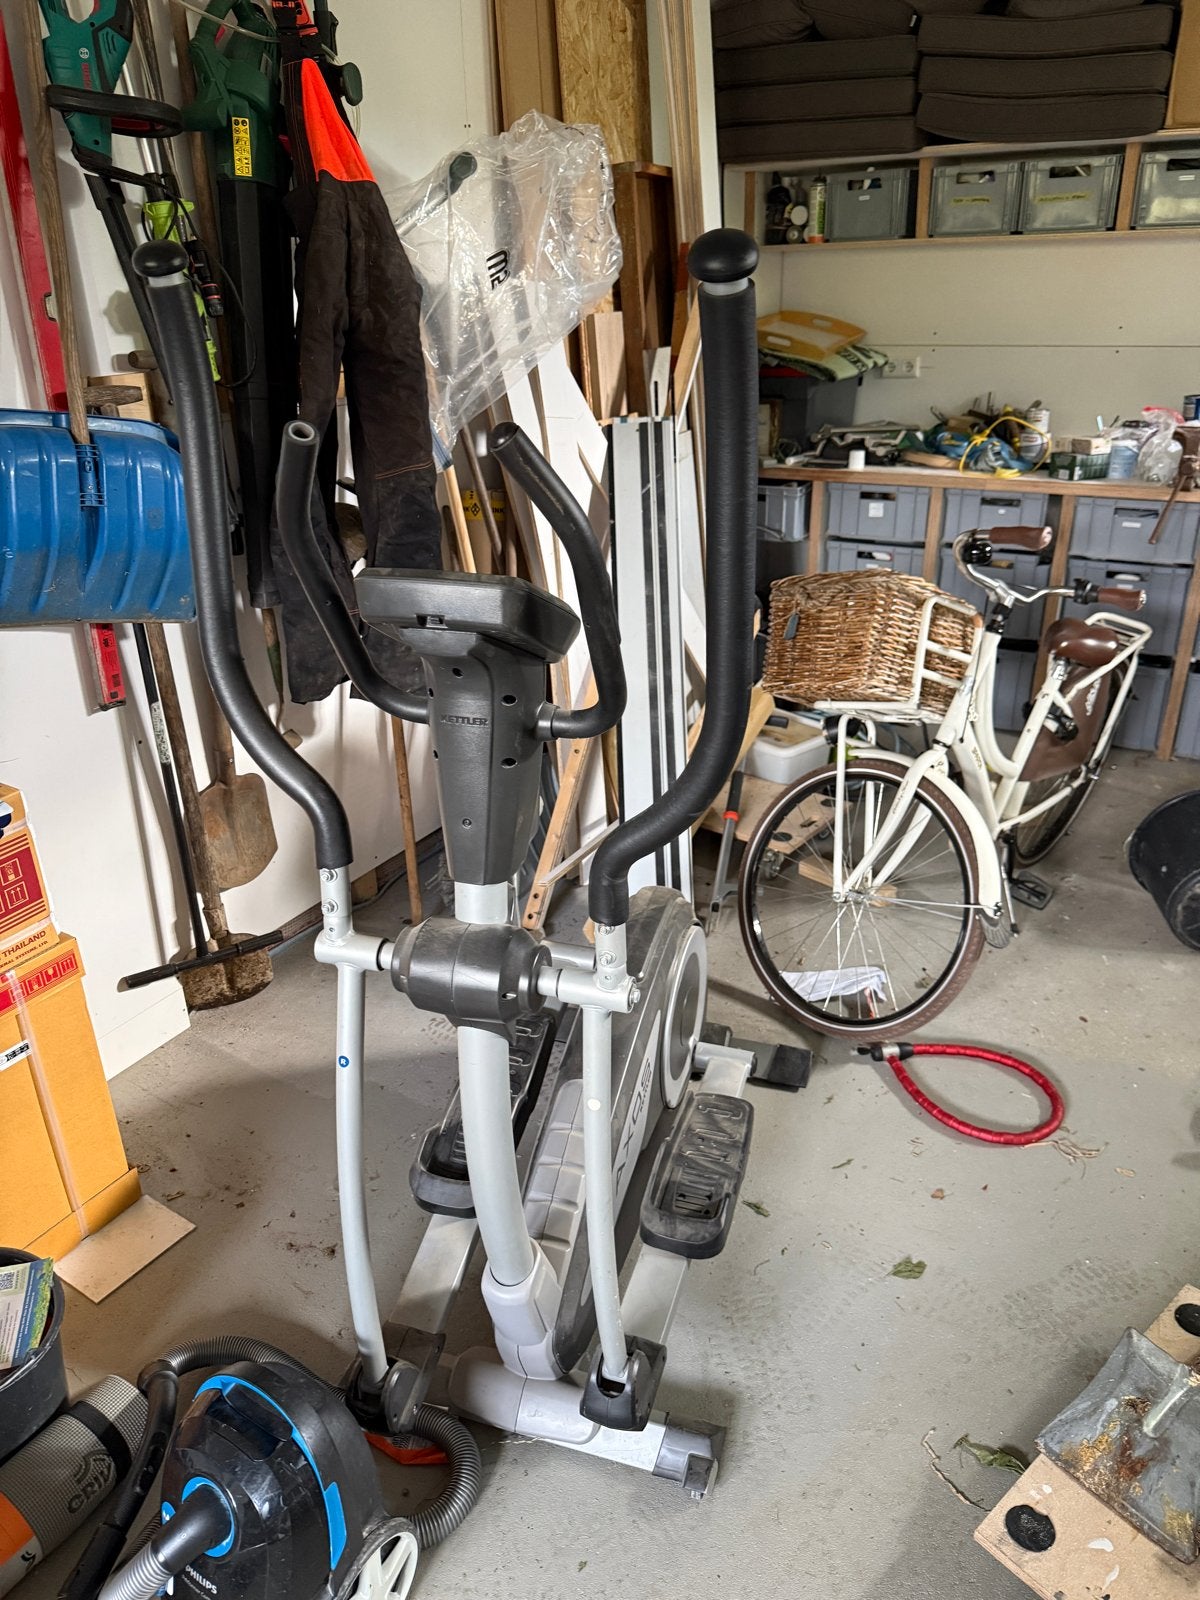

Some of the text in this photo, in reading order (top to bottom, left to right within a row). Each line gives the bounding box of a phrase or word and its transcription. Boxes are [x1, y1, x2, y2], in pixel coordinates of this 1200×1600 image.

[440, 714, 489, 727] KETTLER
[1, 930, 46, 958] THAILAND
[185, 1564, 218, 1595] PHILIPS
